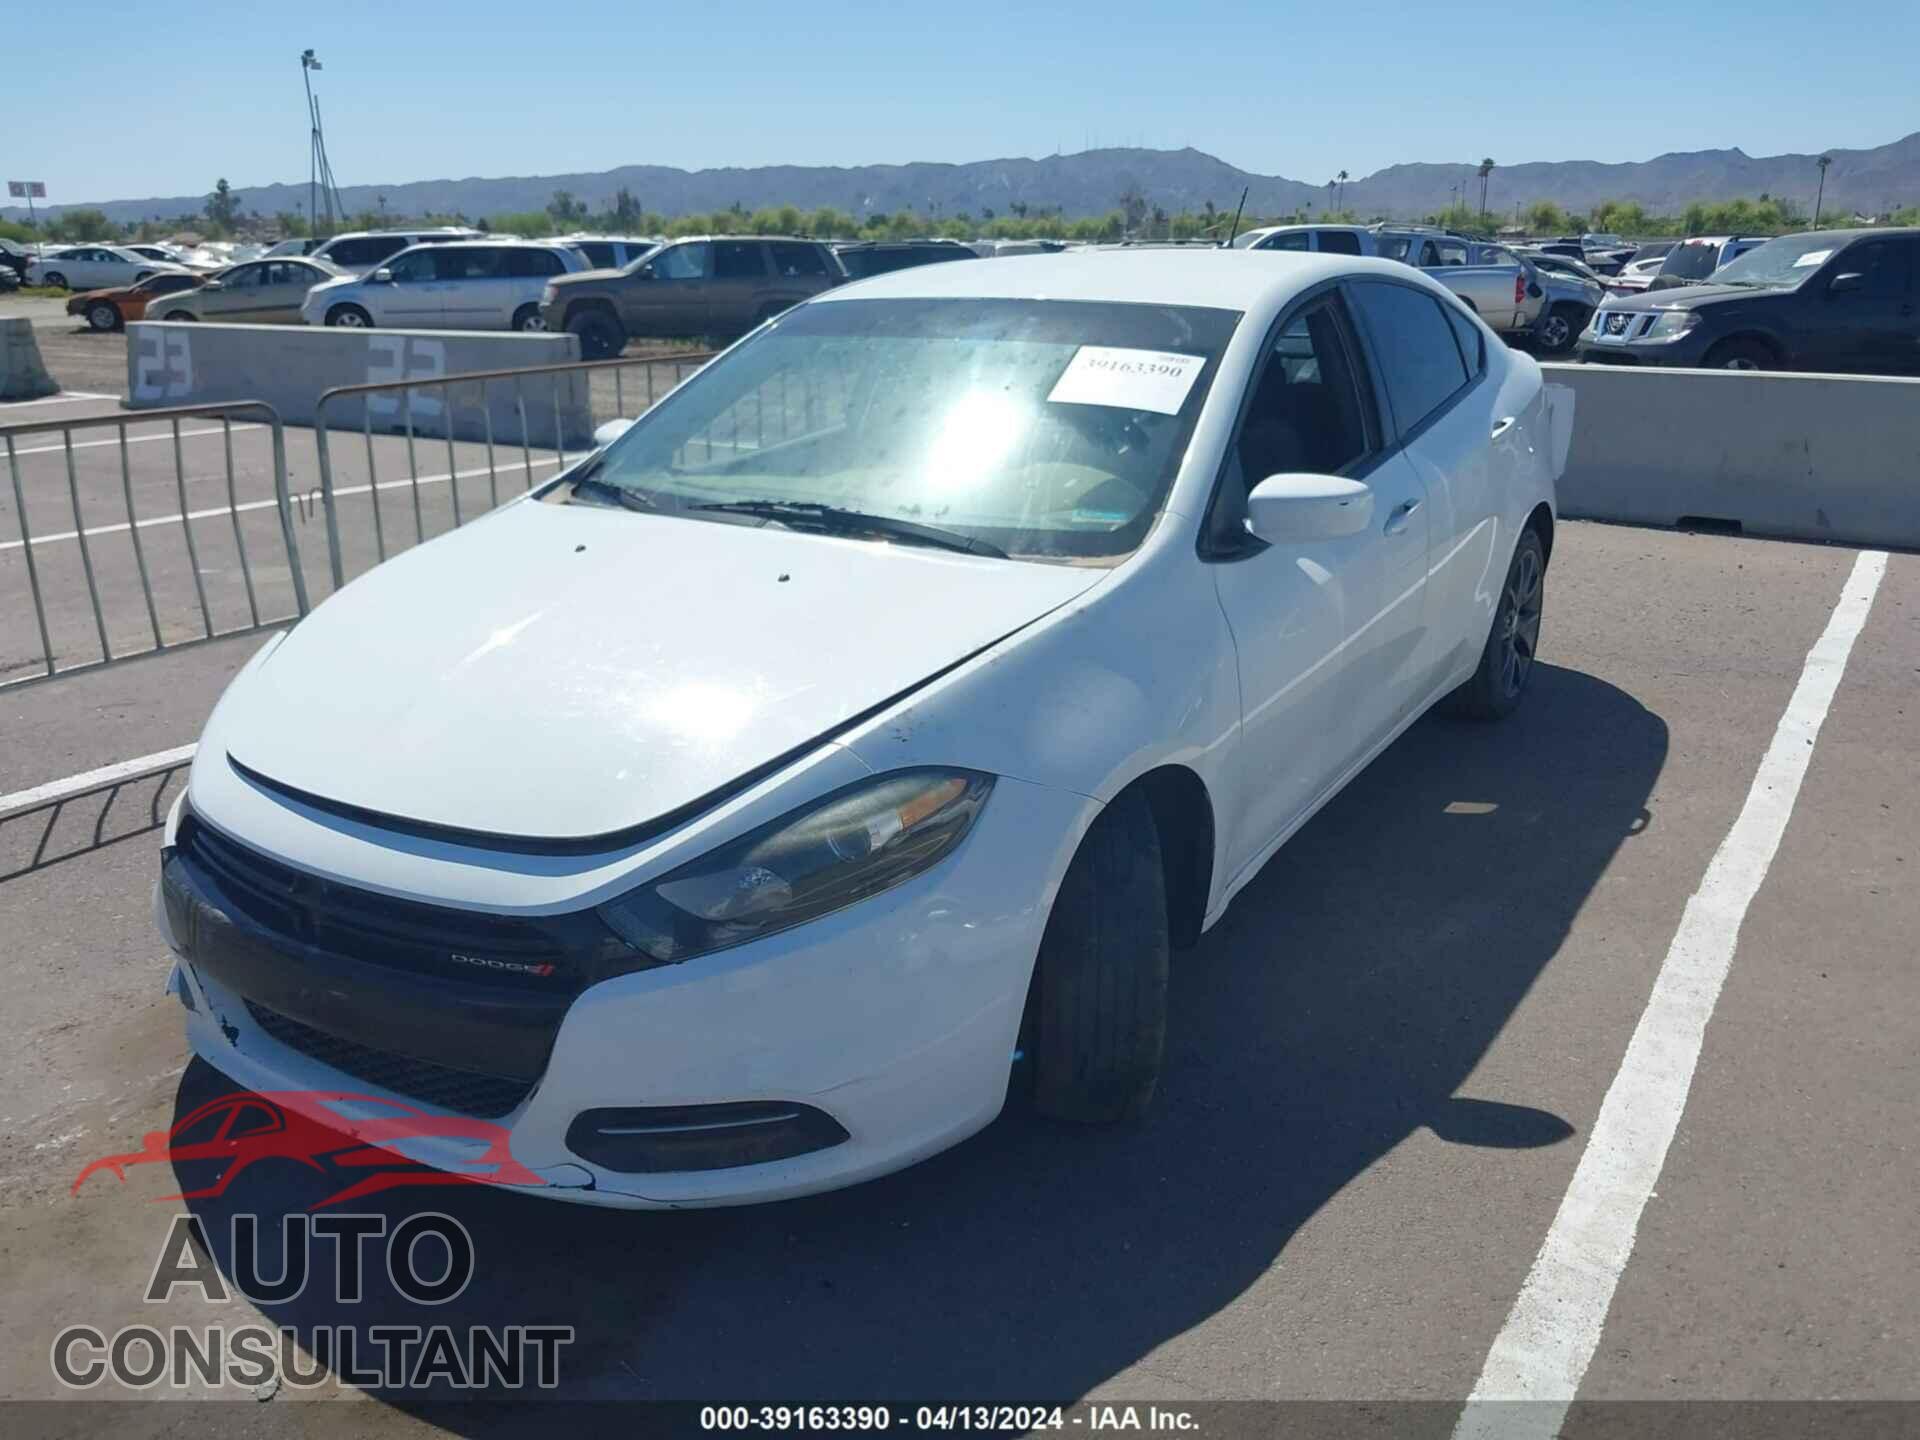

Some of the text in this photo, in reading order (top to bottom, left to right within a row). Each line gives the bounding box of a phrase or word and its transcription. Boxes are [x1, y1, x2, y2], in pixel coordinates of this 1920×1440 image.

[135, 325, 193, 399] 23
[1081, 357, 1183, 378] 39163390
[451, 953, 543, 974] DODGE
